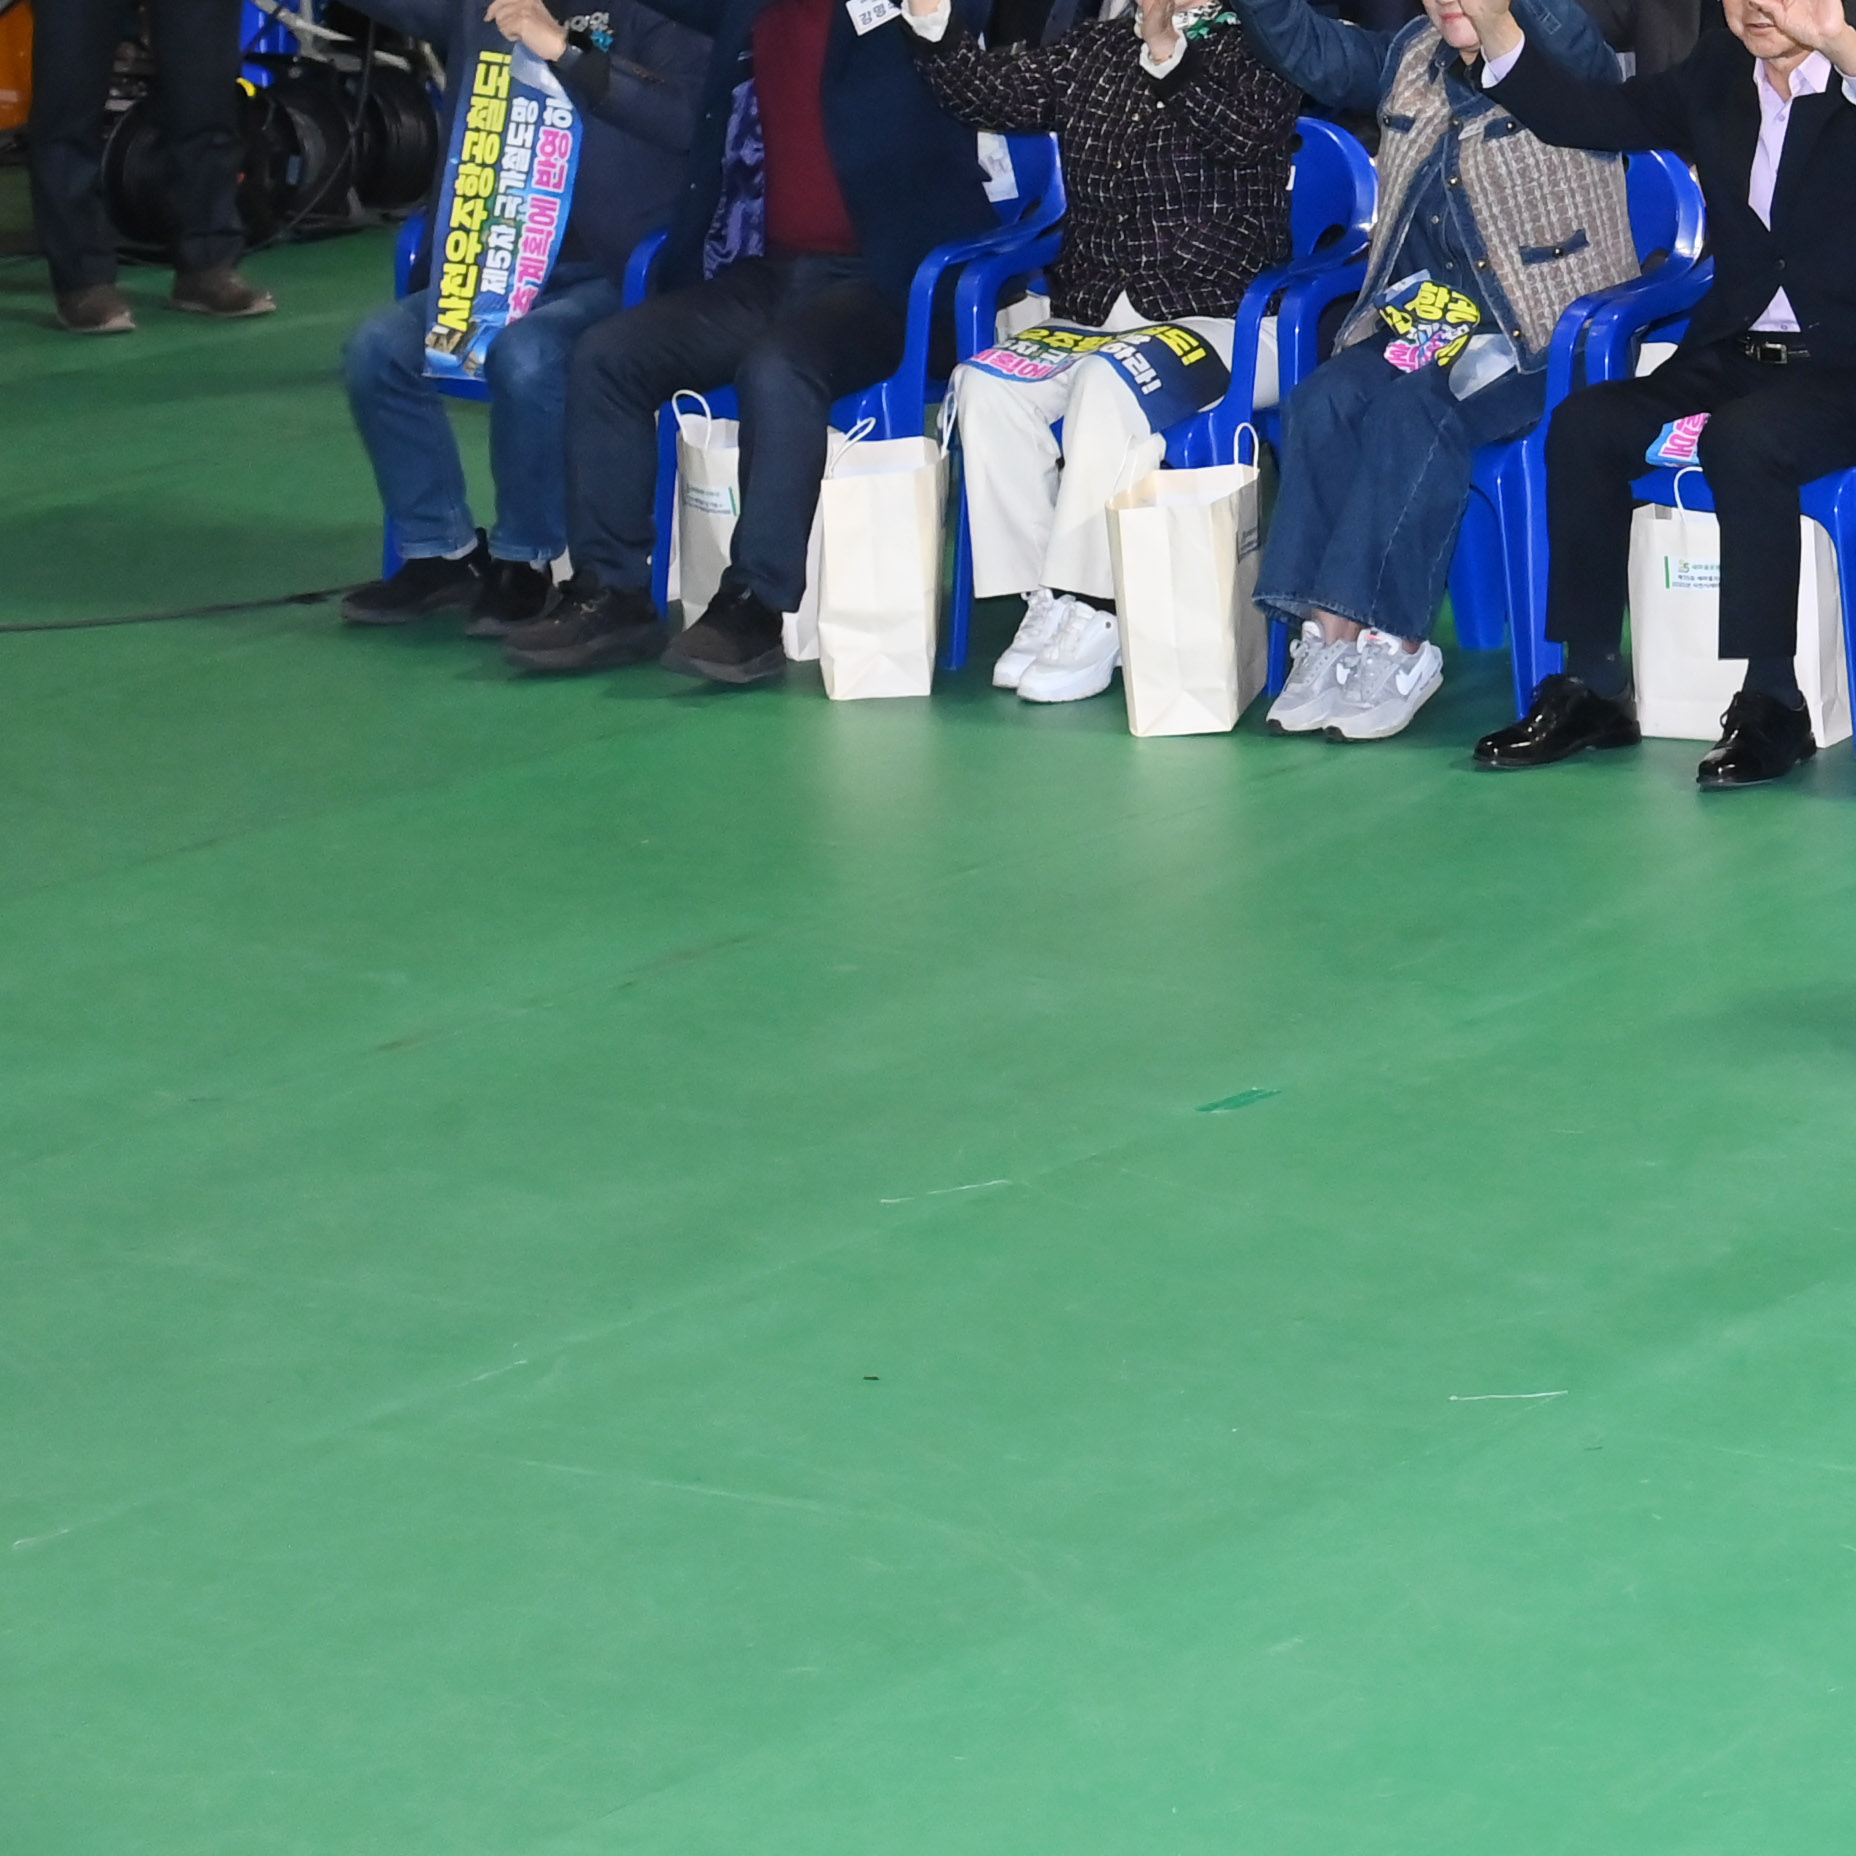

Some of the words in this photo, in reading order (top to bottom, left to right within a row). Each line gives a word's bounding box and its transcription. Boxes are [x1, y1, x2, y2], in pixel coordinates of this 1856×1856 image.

[437, 50, 512, 332] 사천우주항공철도!
[493, 96, 539, 219] 국가철도망
[480, 224, 517, 295] 제5차
